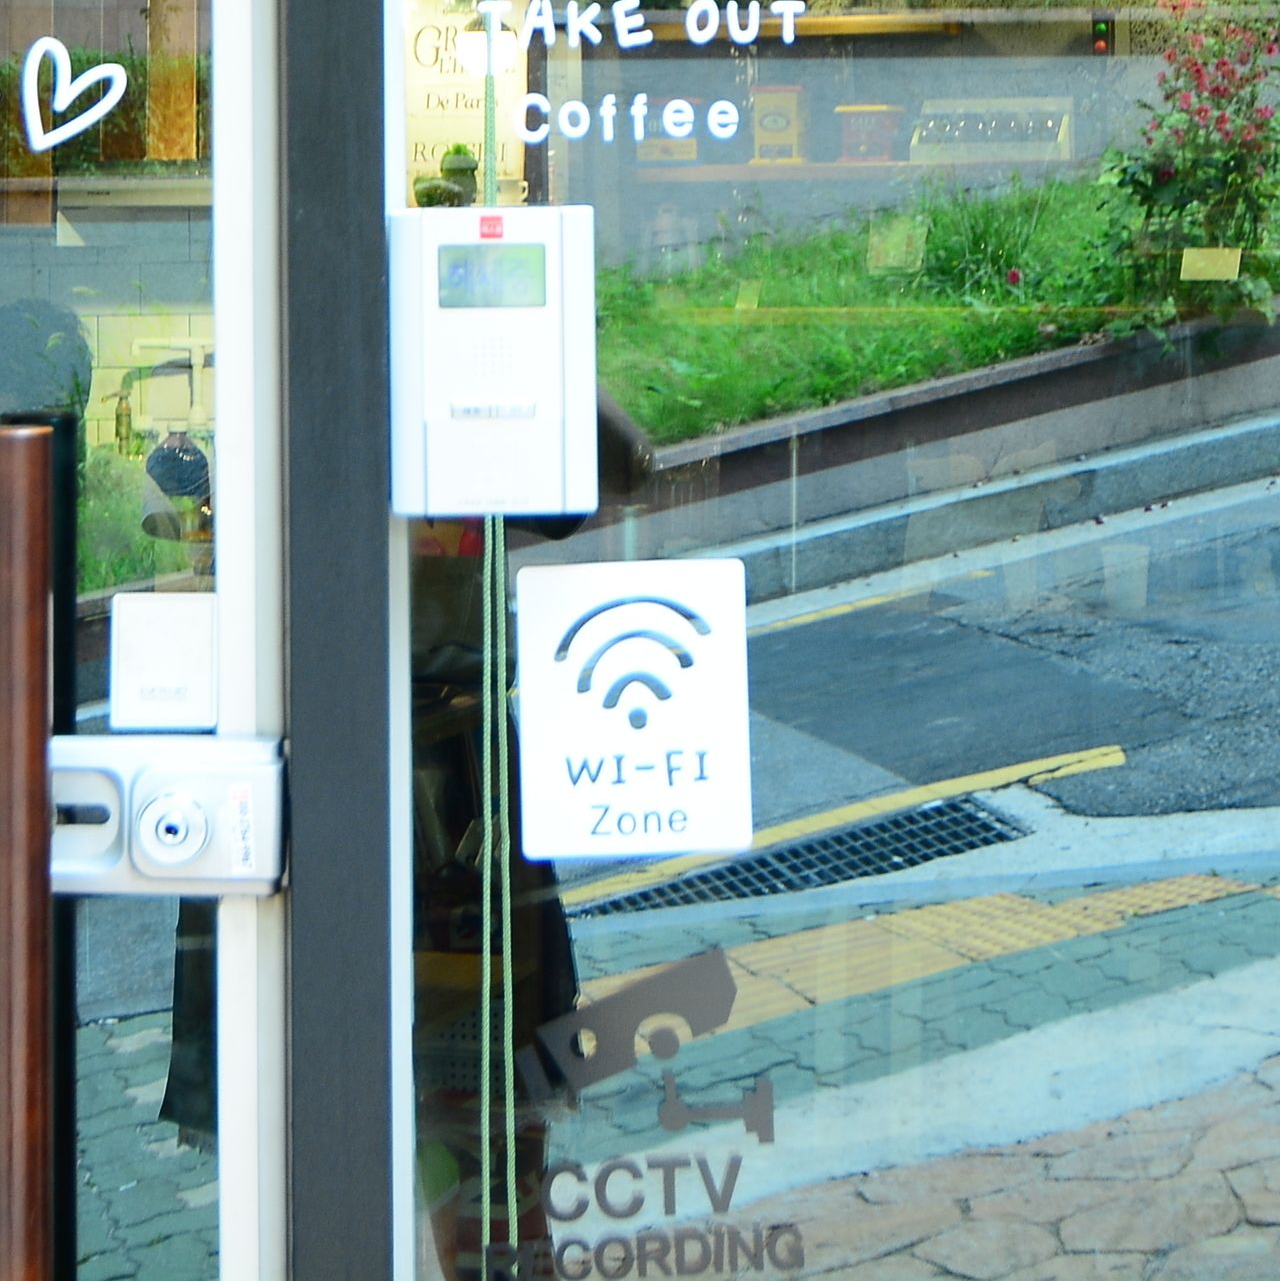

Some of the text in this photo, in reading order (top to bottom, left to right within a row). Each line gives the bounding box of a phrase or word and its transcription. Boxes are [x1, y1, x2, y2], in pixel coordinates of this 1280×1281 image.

[512, 92, 742, 145] Coffee
[565, 749, 710, 789] WI-FI
[590, 804, 689, 837] Zone
[542, 1154, 744, 1221] CCTV
[483, 1223, 806, 1281] RECORDING
